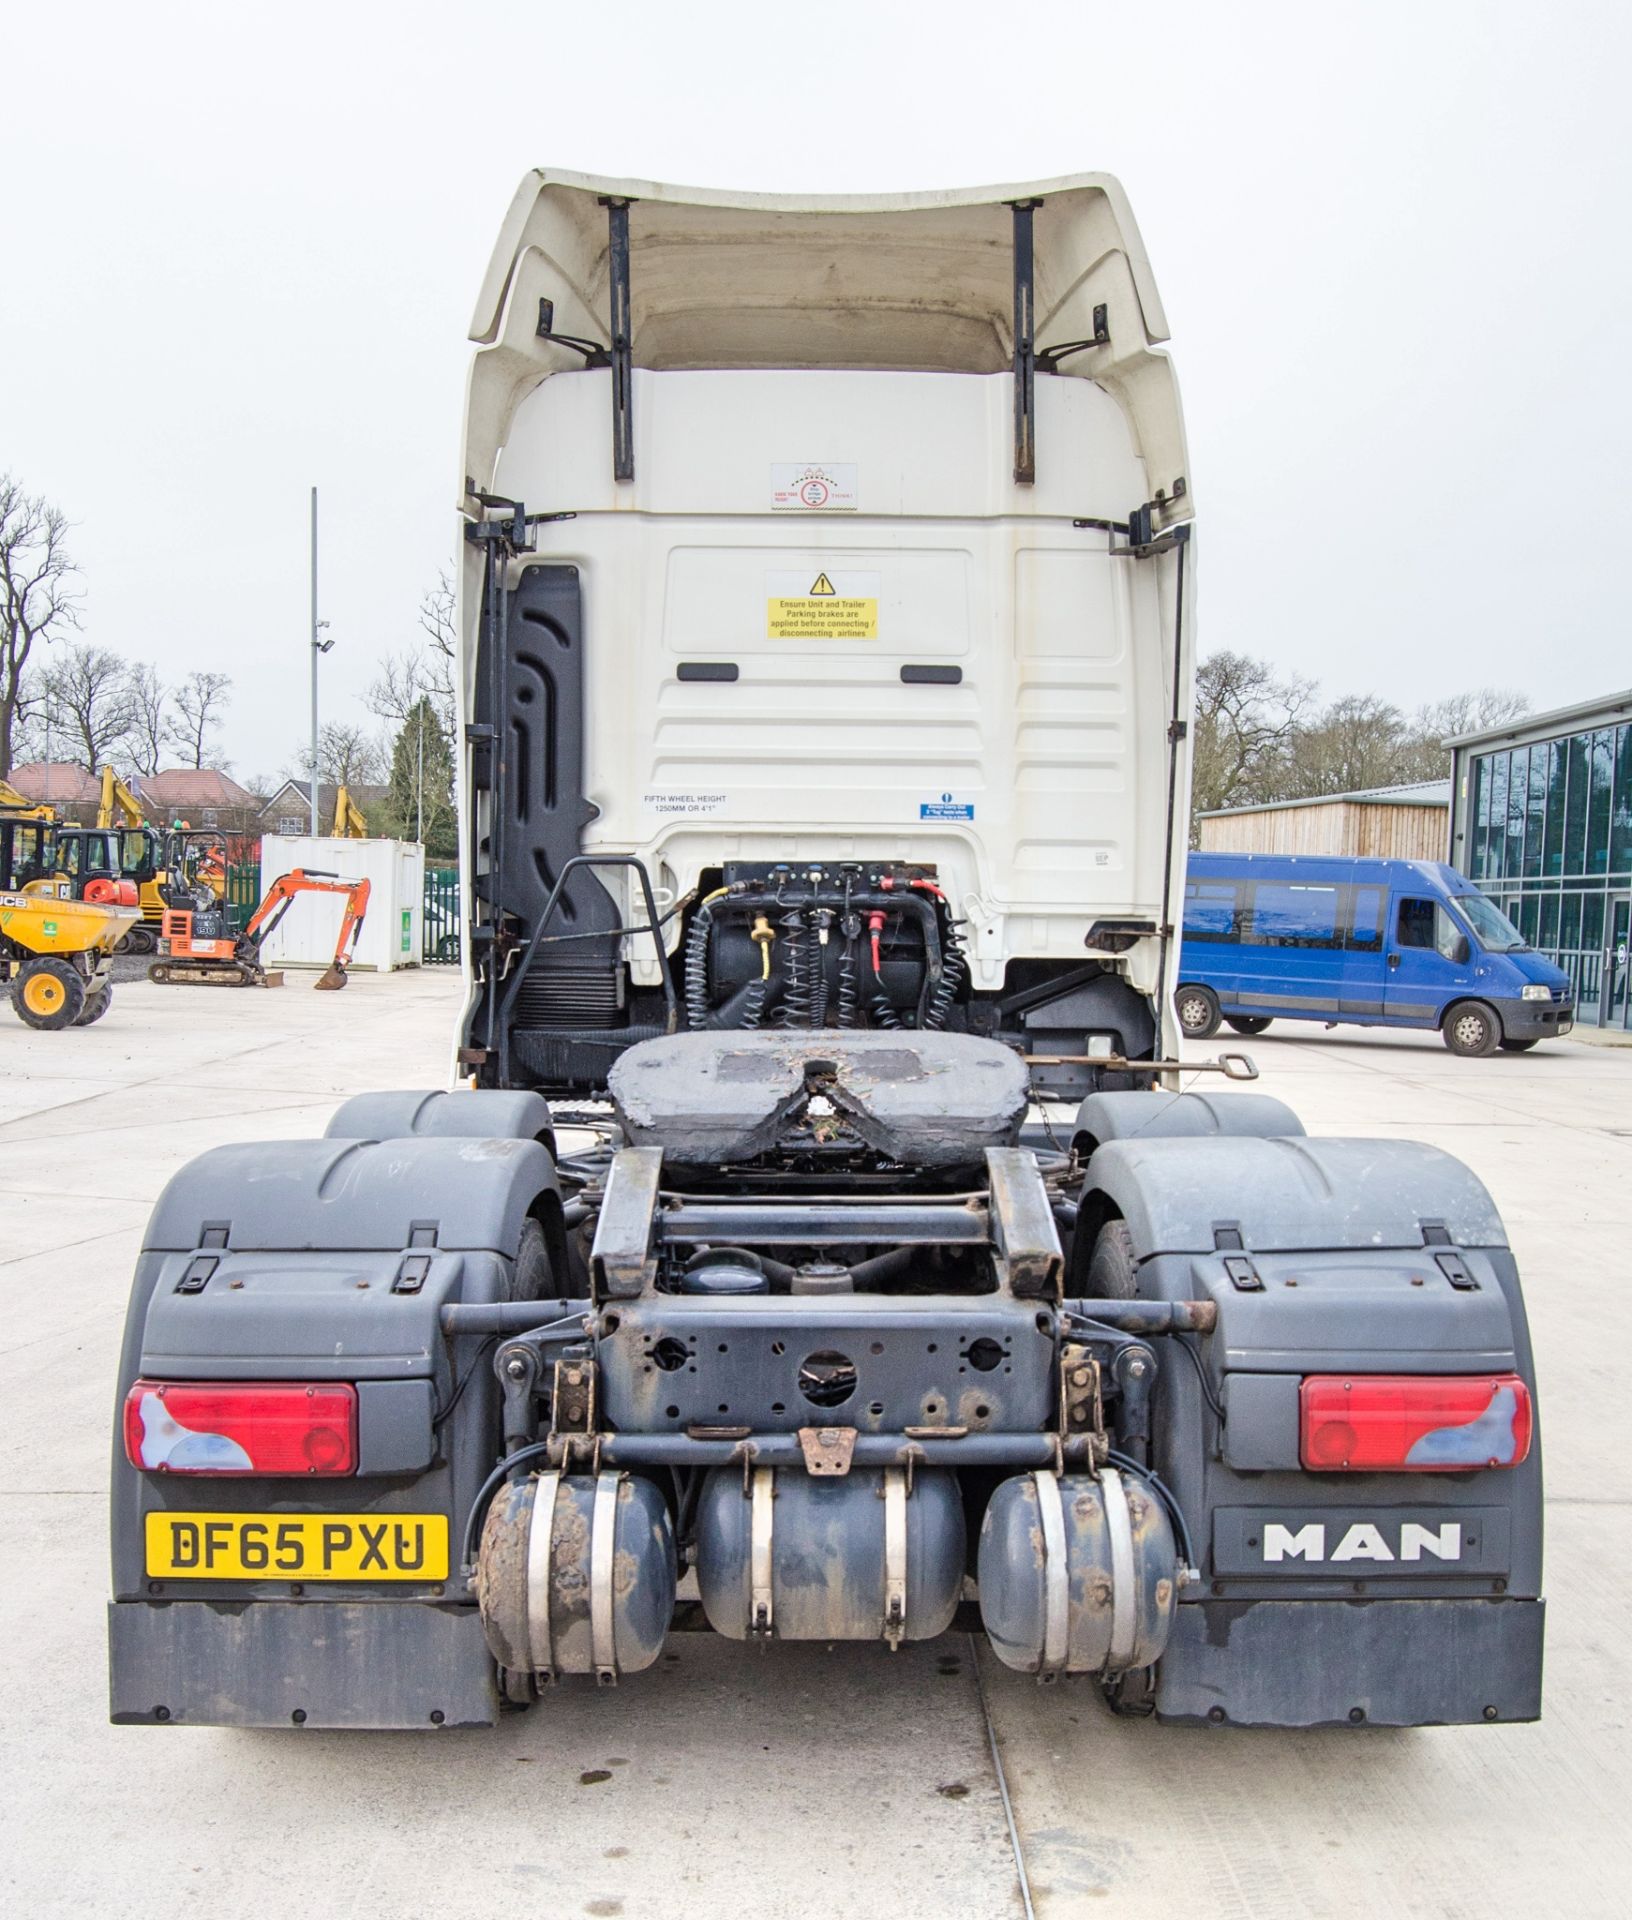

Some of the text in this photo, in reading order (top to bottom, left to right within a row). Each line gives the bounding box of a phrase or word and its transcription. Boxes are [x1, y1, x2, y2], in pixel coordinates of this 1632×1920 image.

[786, 610, 816, 618] Parking
[779, 630, 833, 638] disconnecting
[0, 896, 27, 907] JCB
[170, 1522, 424, 1570] DF65 PXU
[1263, 1523, 1460, 1562] MAN
